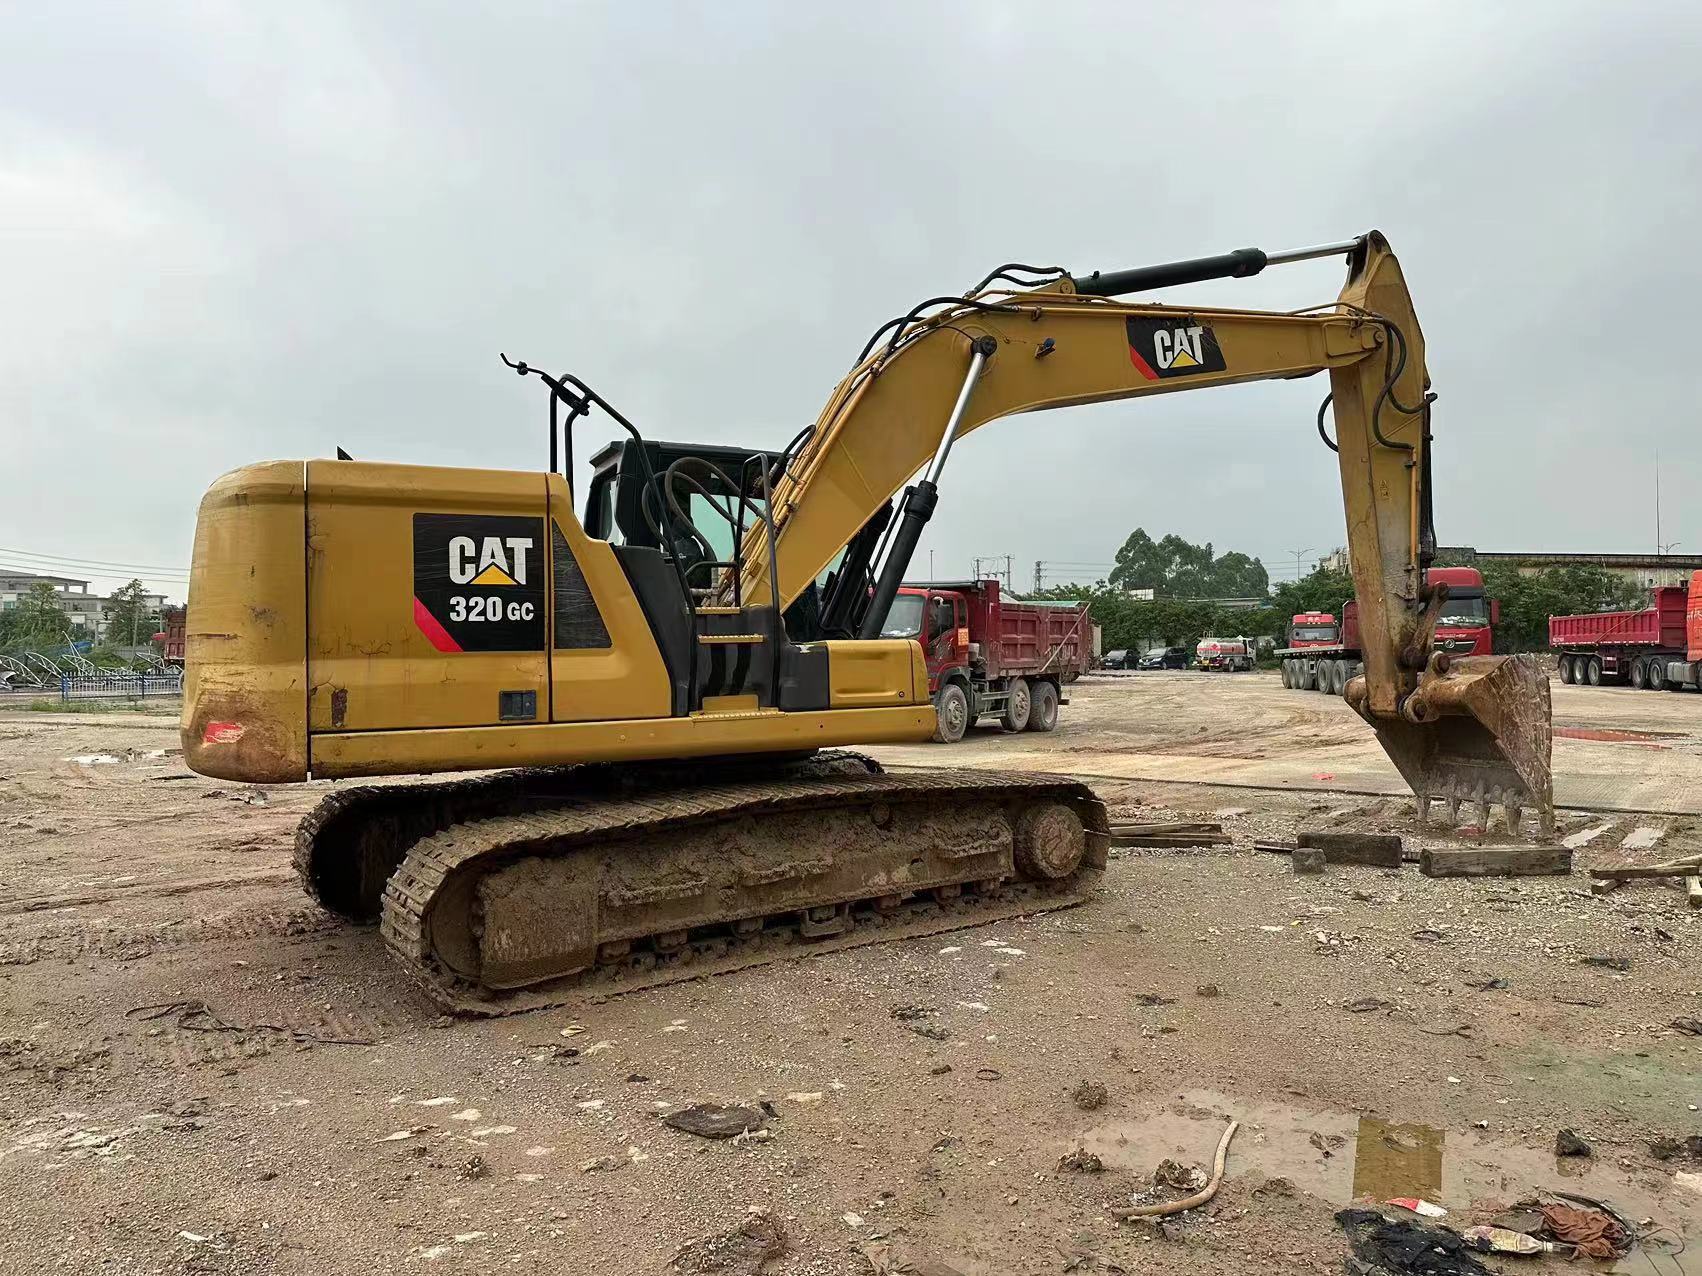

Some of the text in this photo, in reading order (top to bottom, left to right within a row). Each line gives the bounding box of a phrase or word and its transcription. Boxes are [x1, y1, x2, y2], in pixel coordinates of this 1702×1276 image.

[1153, 326, 1204, 369] CAT
[448, 536, 533, 585] CAT
[449, 596, 534, 622] 320 GC
